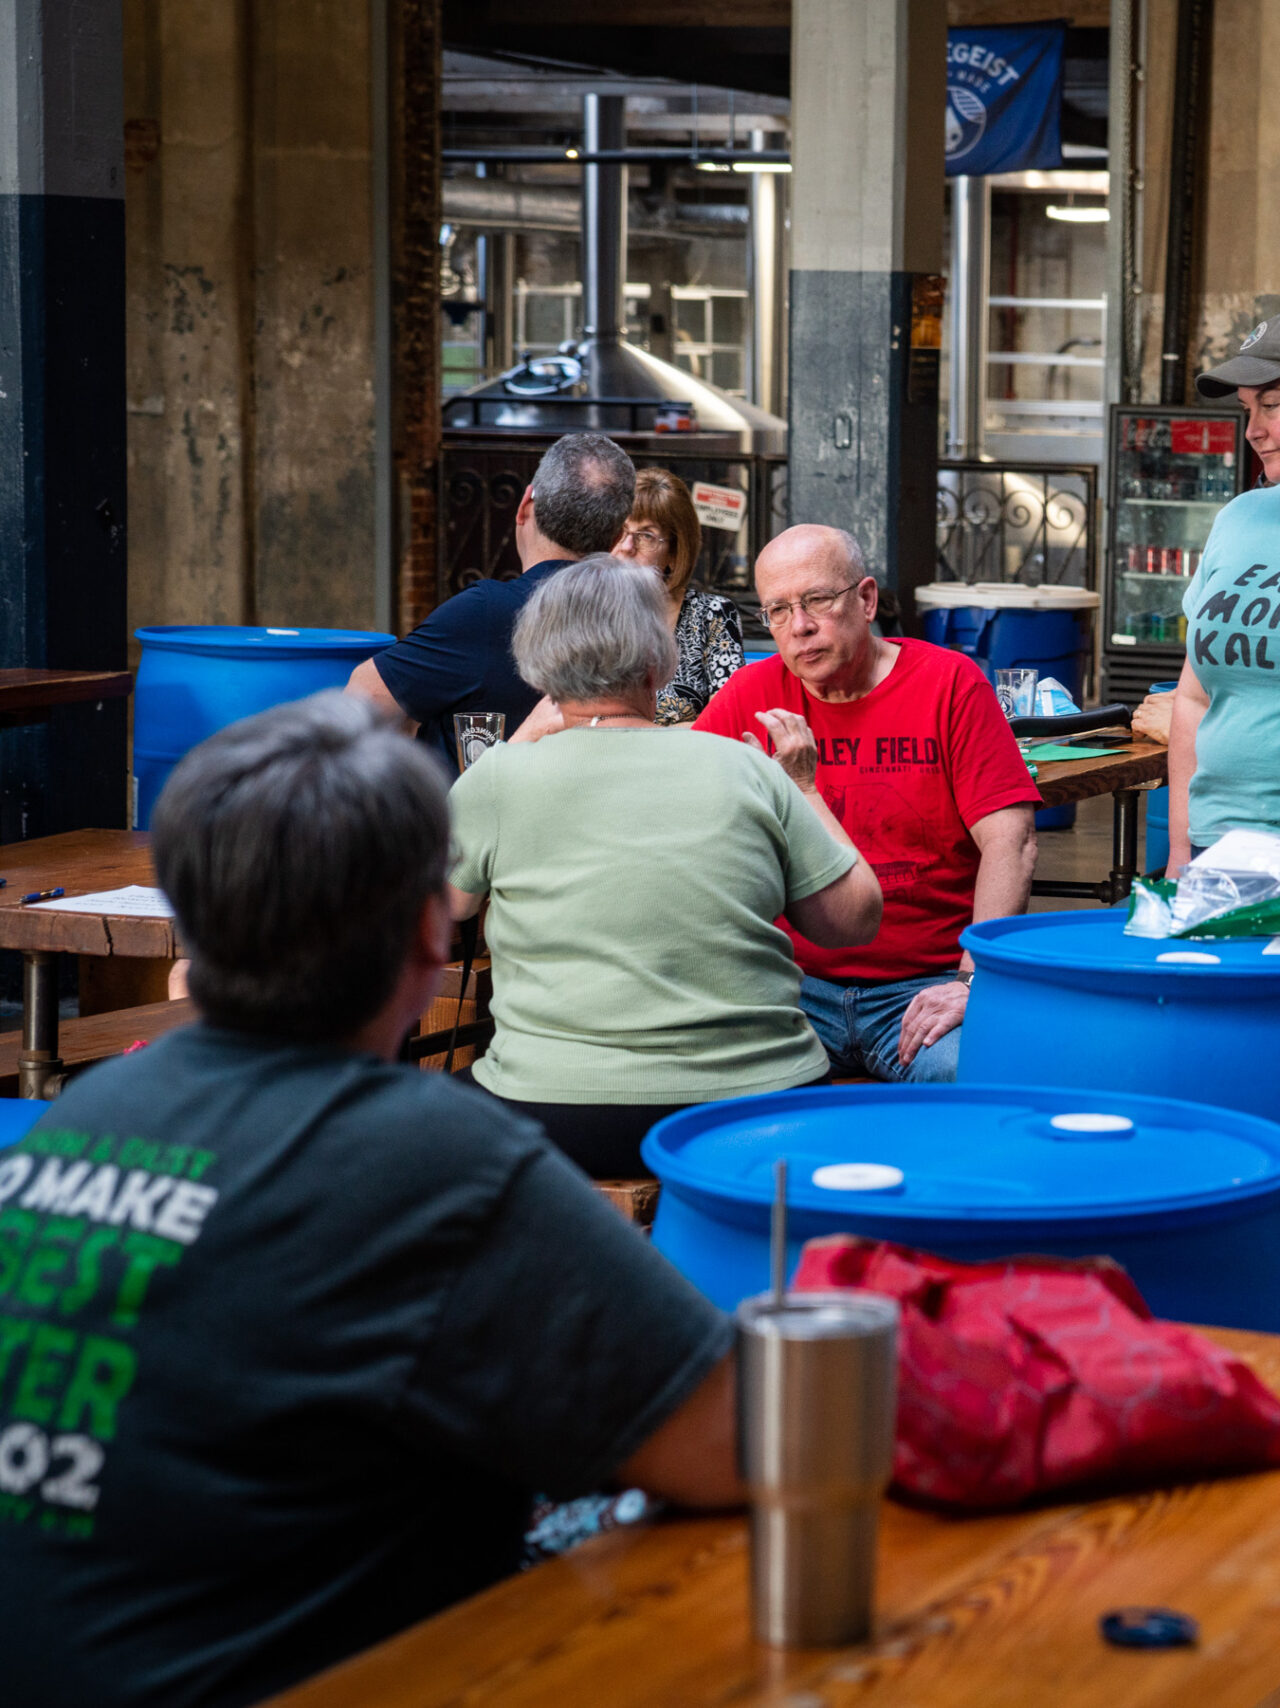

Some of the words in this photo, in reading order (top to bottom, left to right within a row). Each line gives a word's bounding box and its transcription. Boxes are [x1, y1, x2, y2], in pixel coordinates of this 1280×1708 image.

[815, 737, 861, 766] LEY
[875, 737, 940, 766] FIELD
[19, 1157, 219, 1246] MAKE
